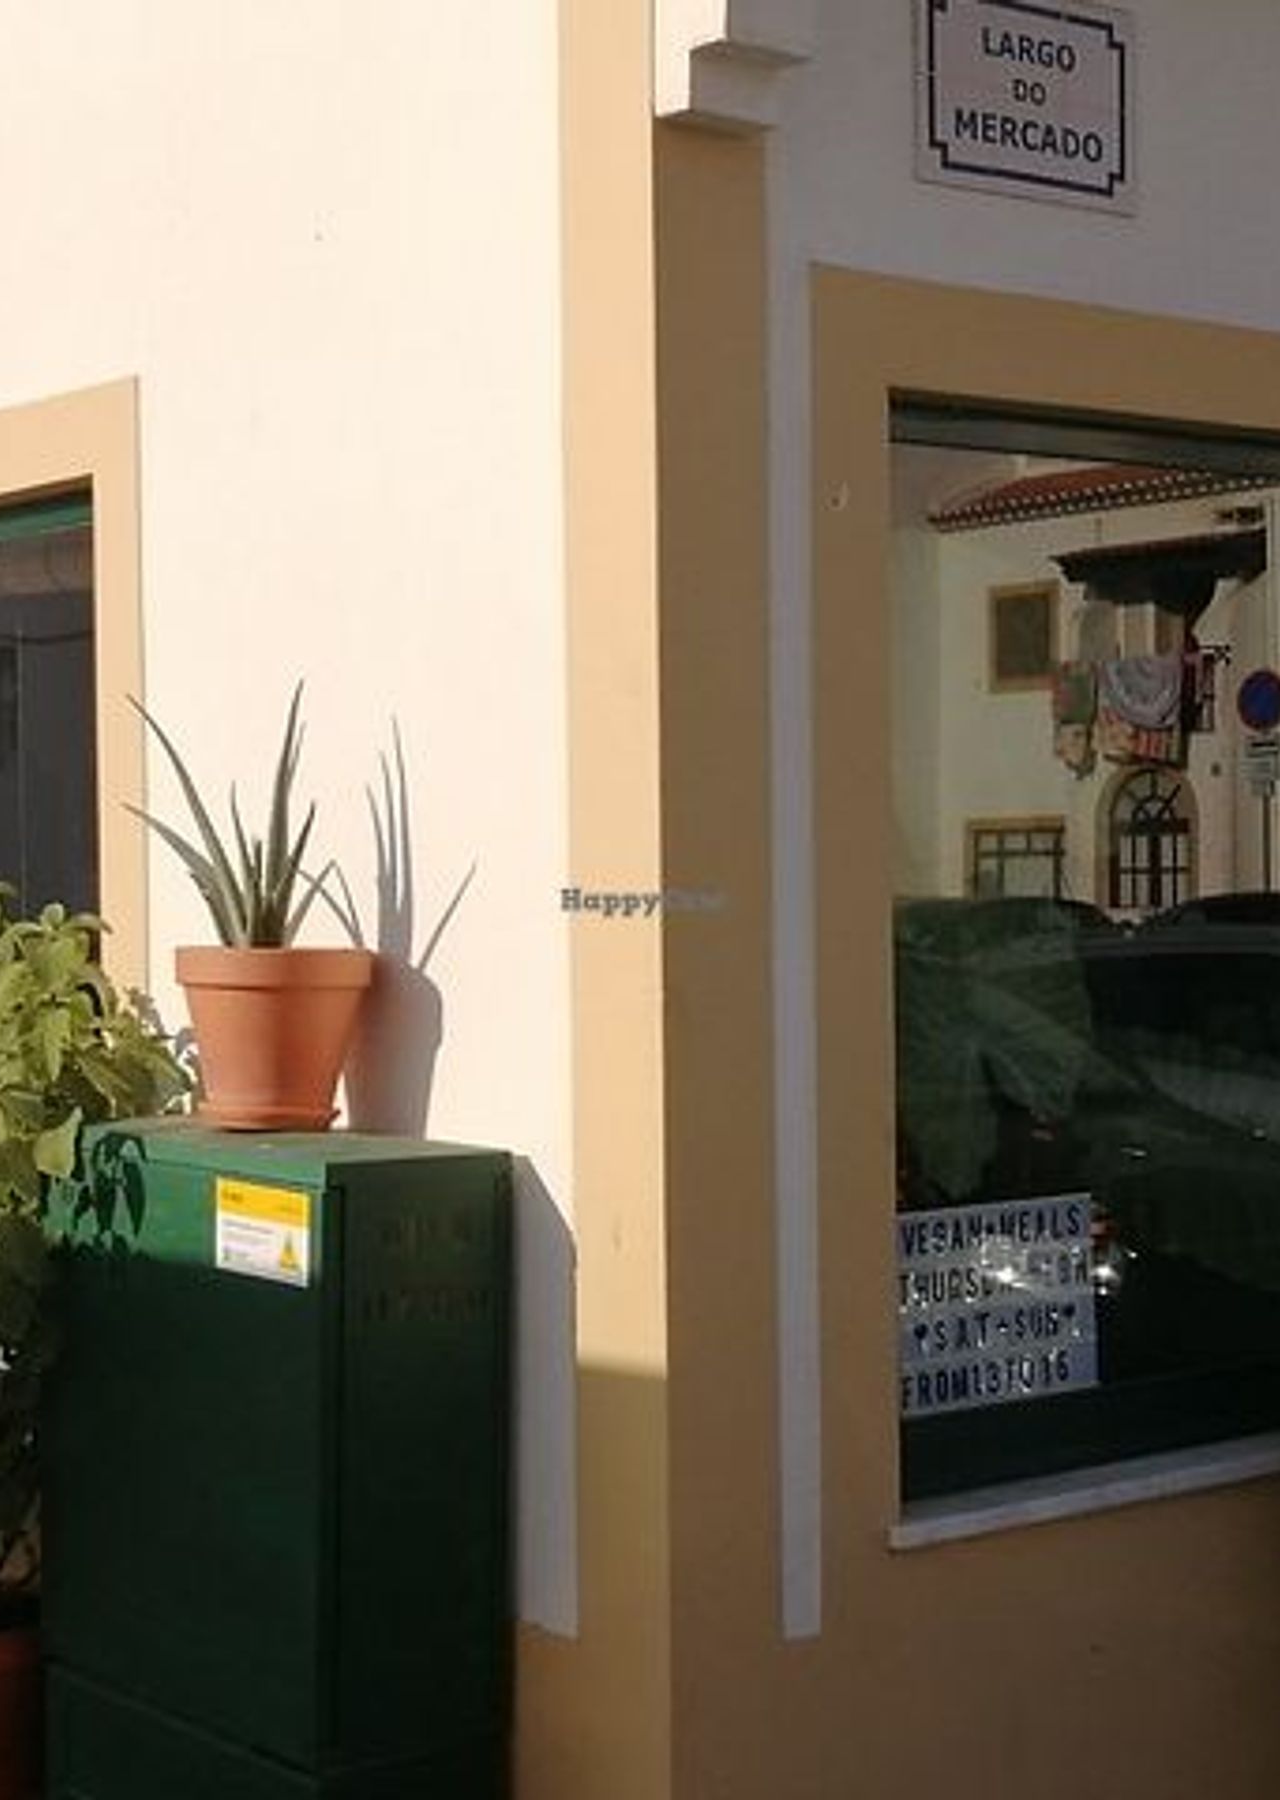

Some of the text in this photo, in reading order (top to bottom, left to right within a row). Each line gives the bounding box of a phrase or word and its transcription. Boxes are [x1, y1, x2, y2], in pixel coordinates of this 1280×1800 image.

[981, 25, 1076, 73] LARGO
[1011, 78, 1047, 106] DO
[954, 107, 1104, 163] MERCADO
